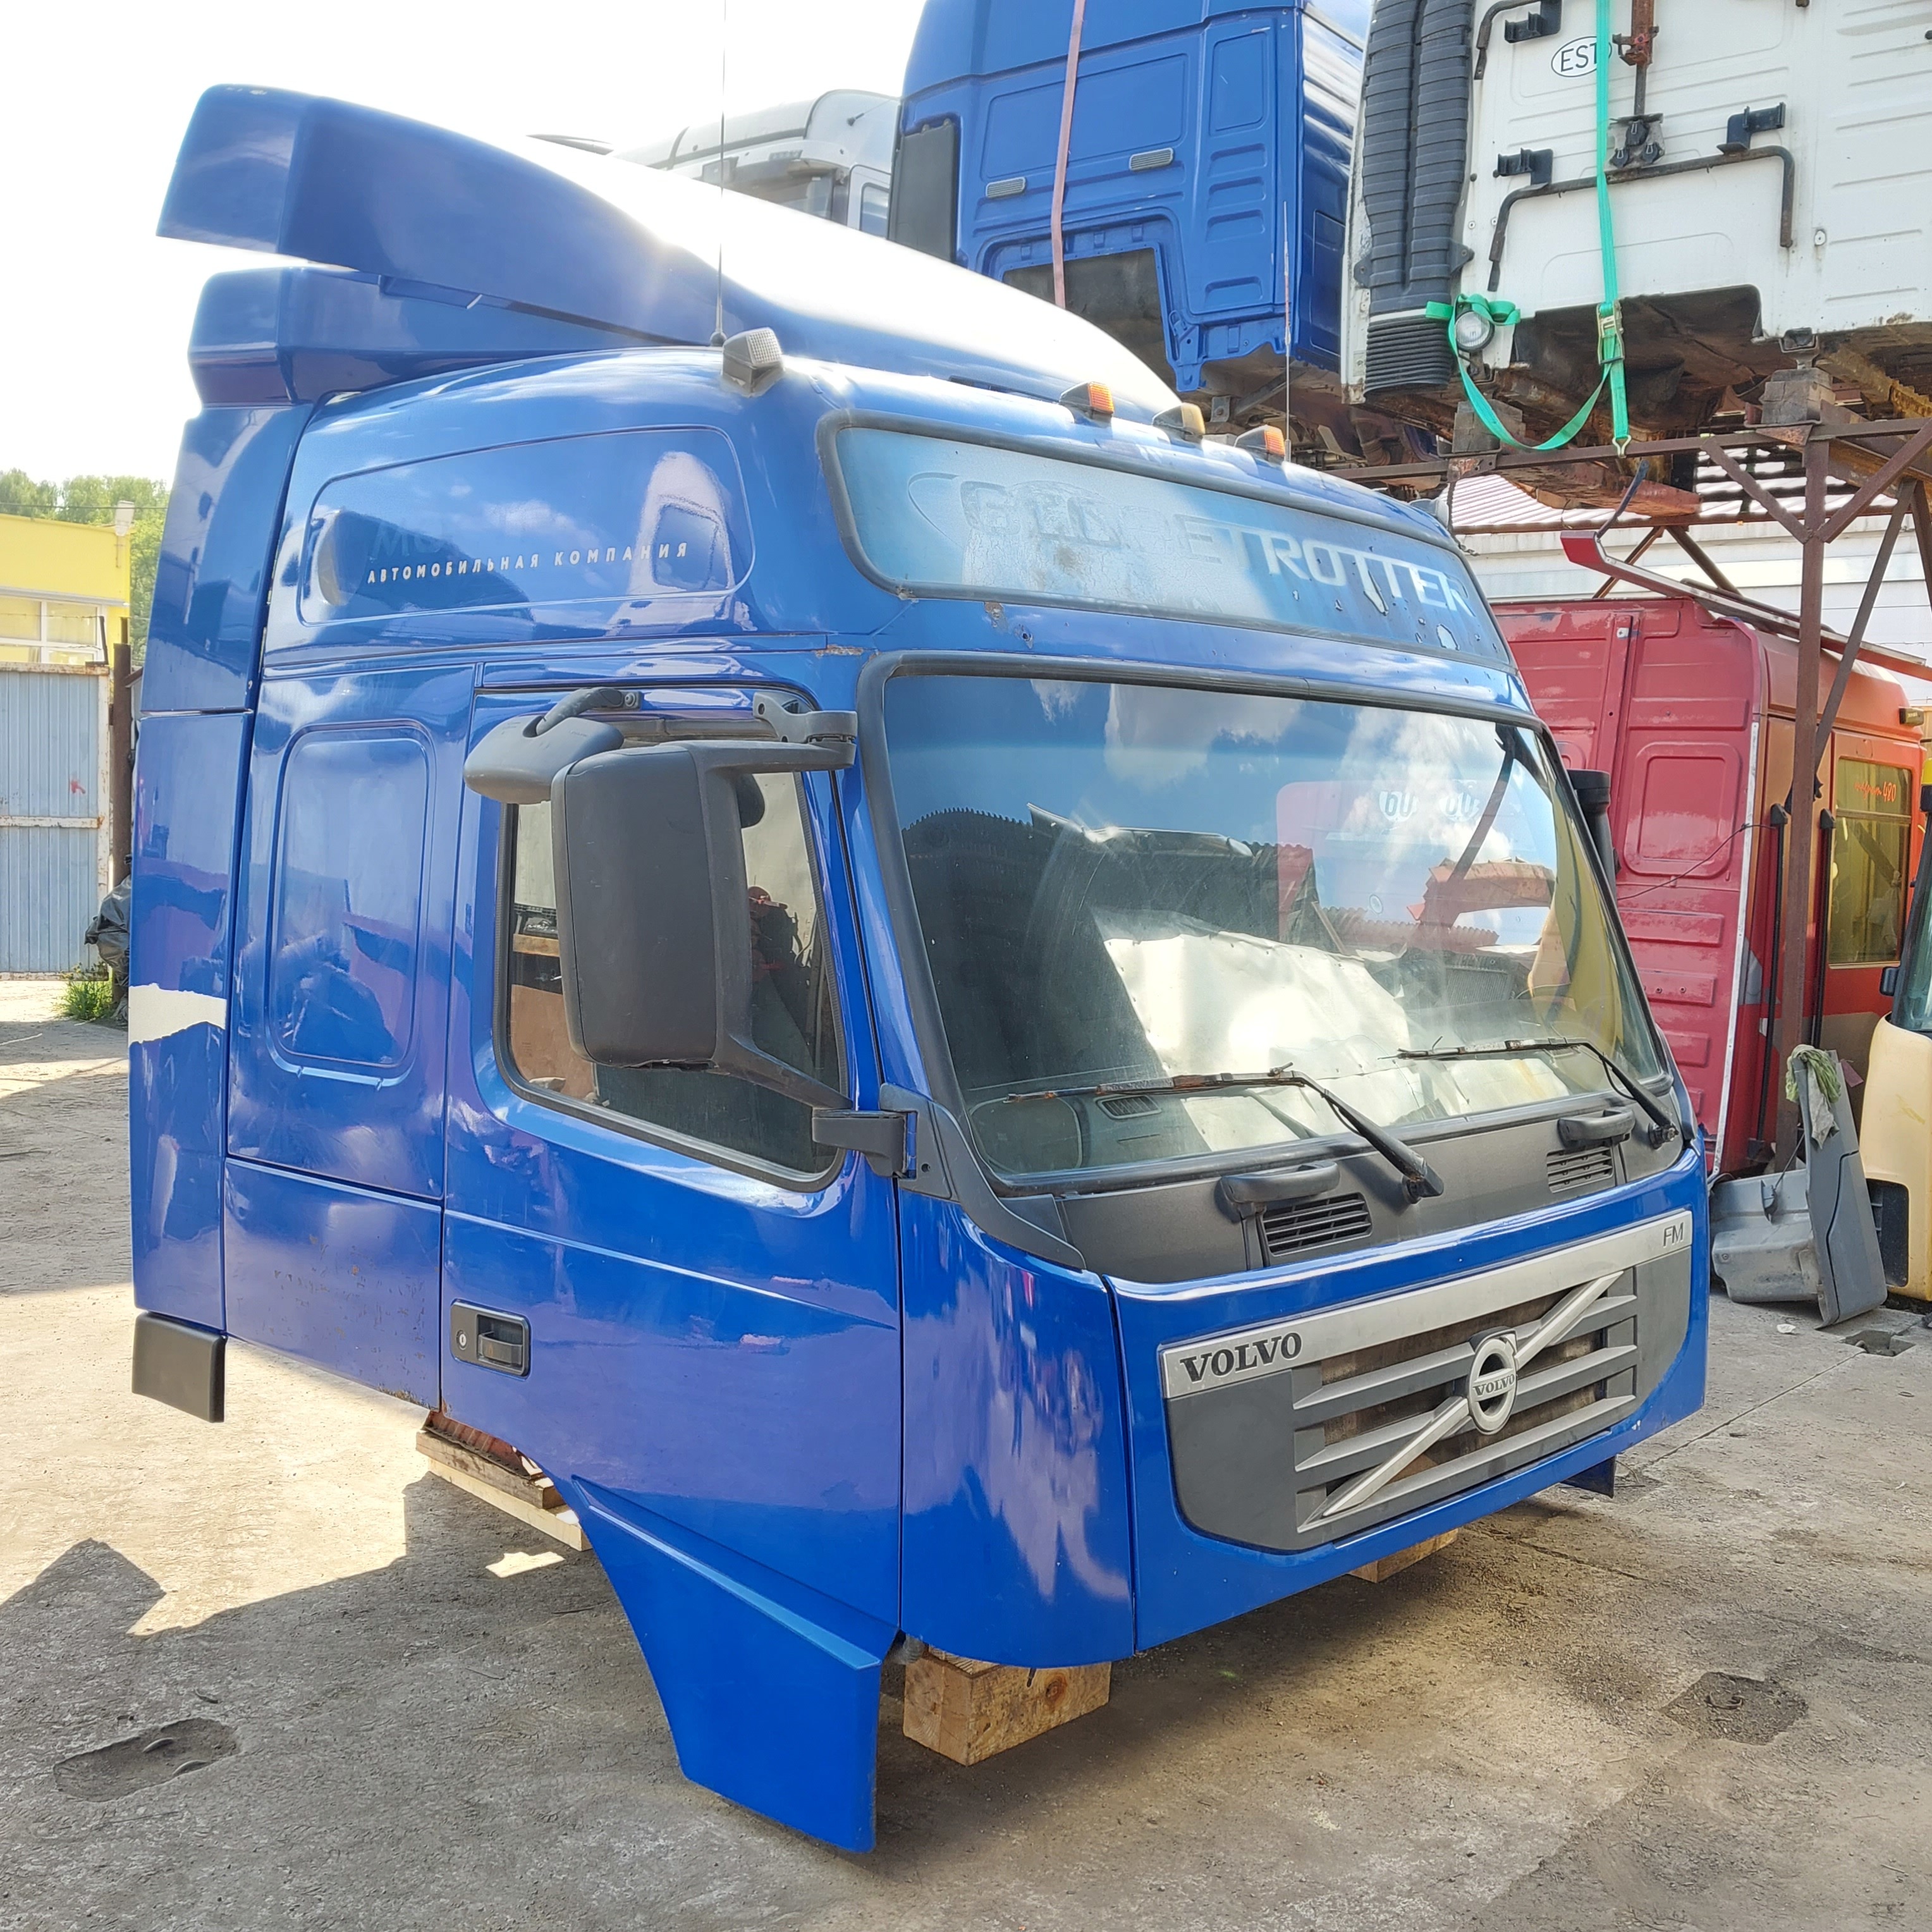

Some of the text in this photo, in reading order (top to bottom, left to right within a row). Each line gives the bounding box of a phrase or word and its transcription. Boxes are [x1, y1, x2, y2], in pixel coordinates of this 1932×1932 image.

[1560, 42, 1598, 72] EST
[367, 542, 687, 584] АВТОМОБИЛЬНАЯ КОМПАНИЯ
[1883, 781, 1897, 802] 480
[1663, 1221, 1684, 1247] FM
[1179, 1332, 1302, 1383] VOLVO
[1472, 1373, 1515, 1397] VOLVO
